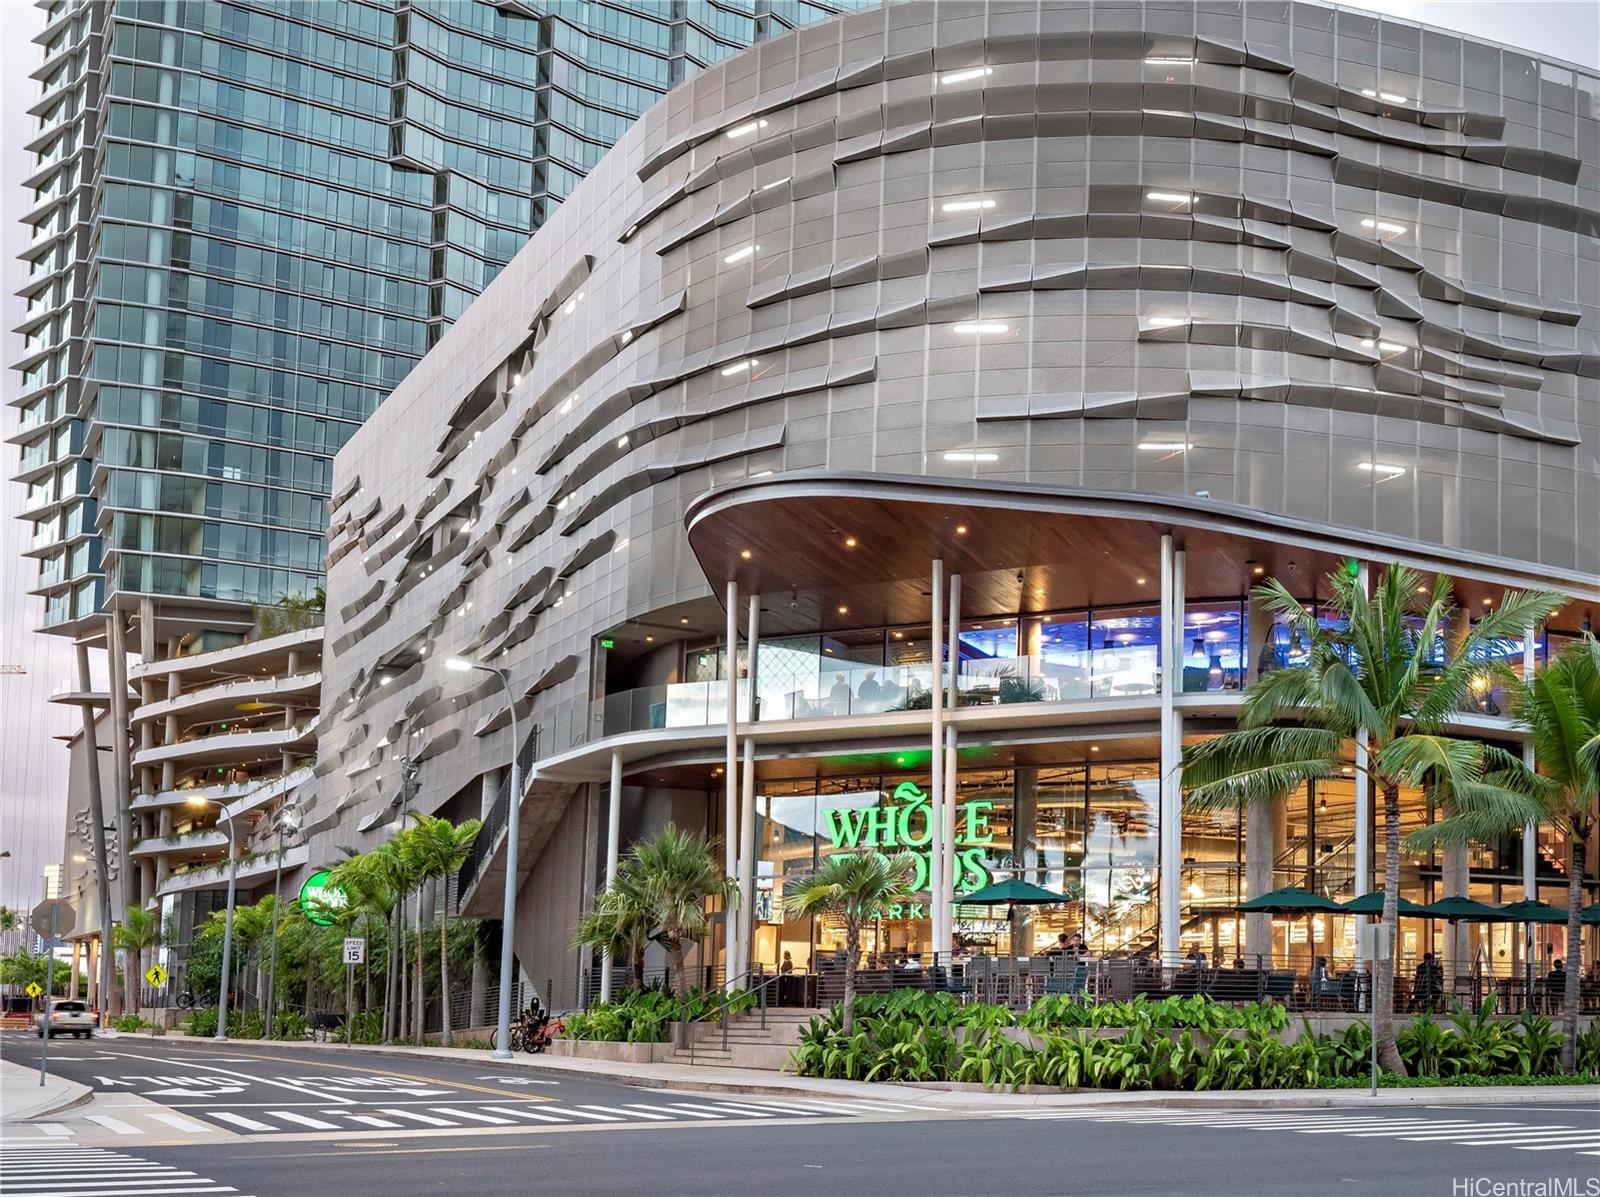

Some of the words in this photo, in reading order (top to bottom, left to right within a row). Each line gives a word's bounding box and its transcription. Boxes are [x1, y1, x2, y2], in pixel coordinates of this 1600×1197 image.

[348, 951, 360, 960] 15
[93, 1076, 252, 1086] ONLY
[274, 1077, 428, 1086] ONLY
